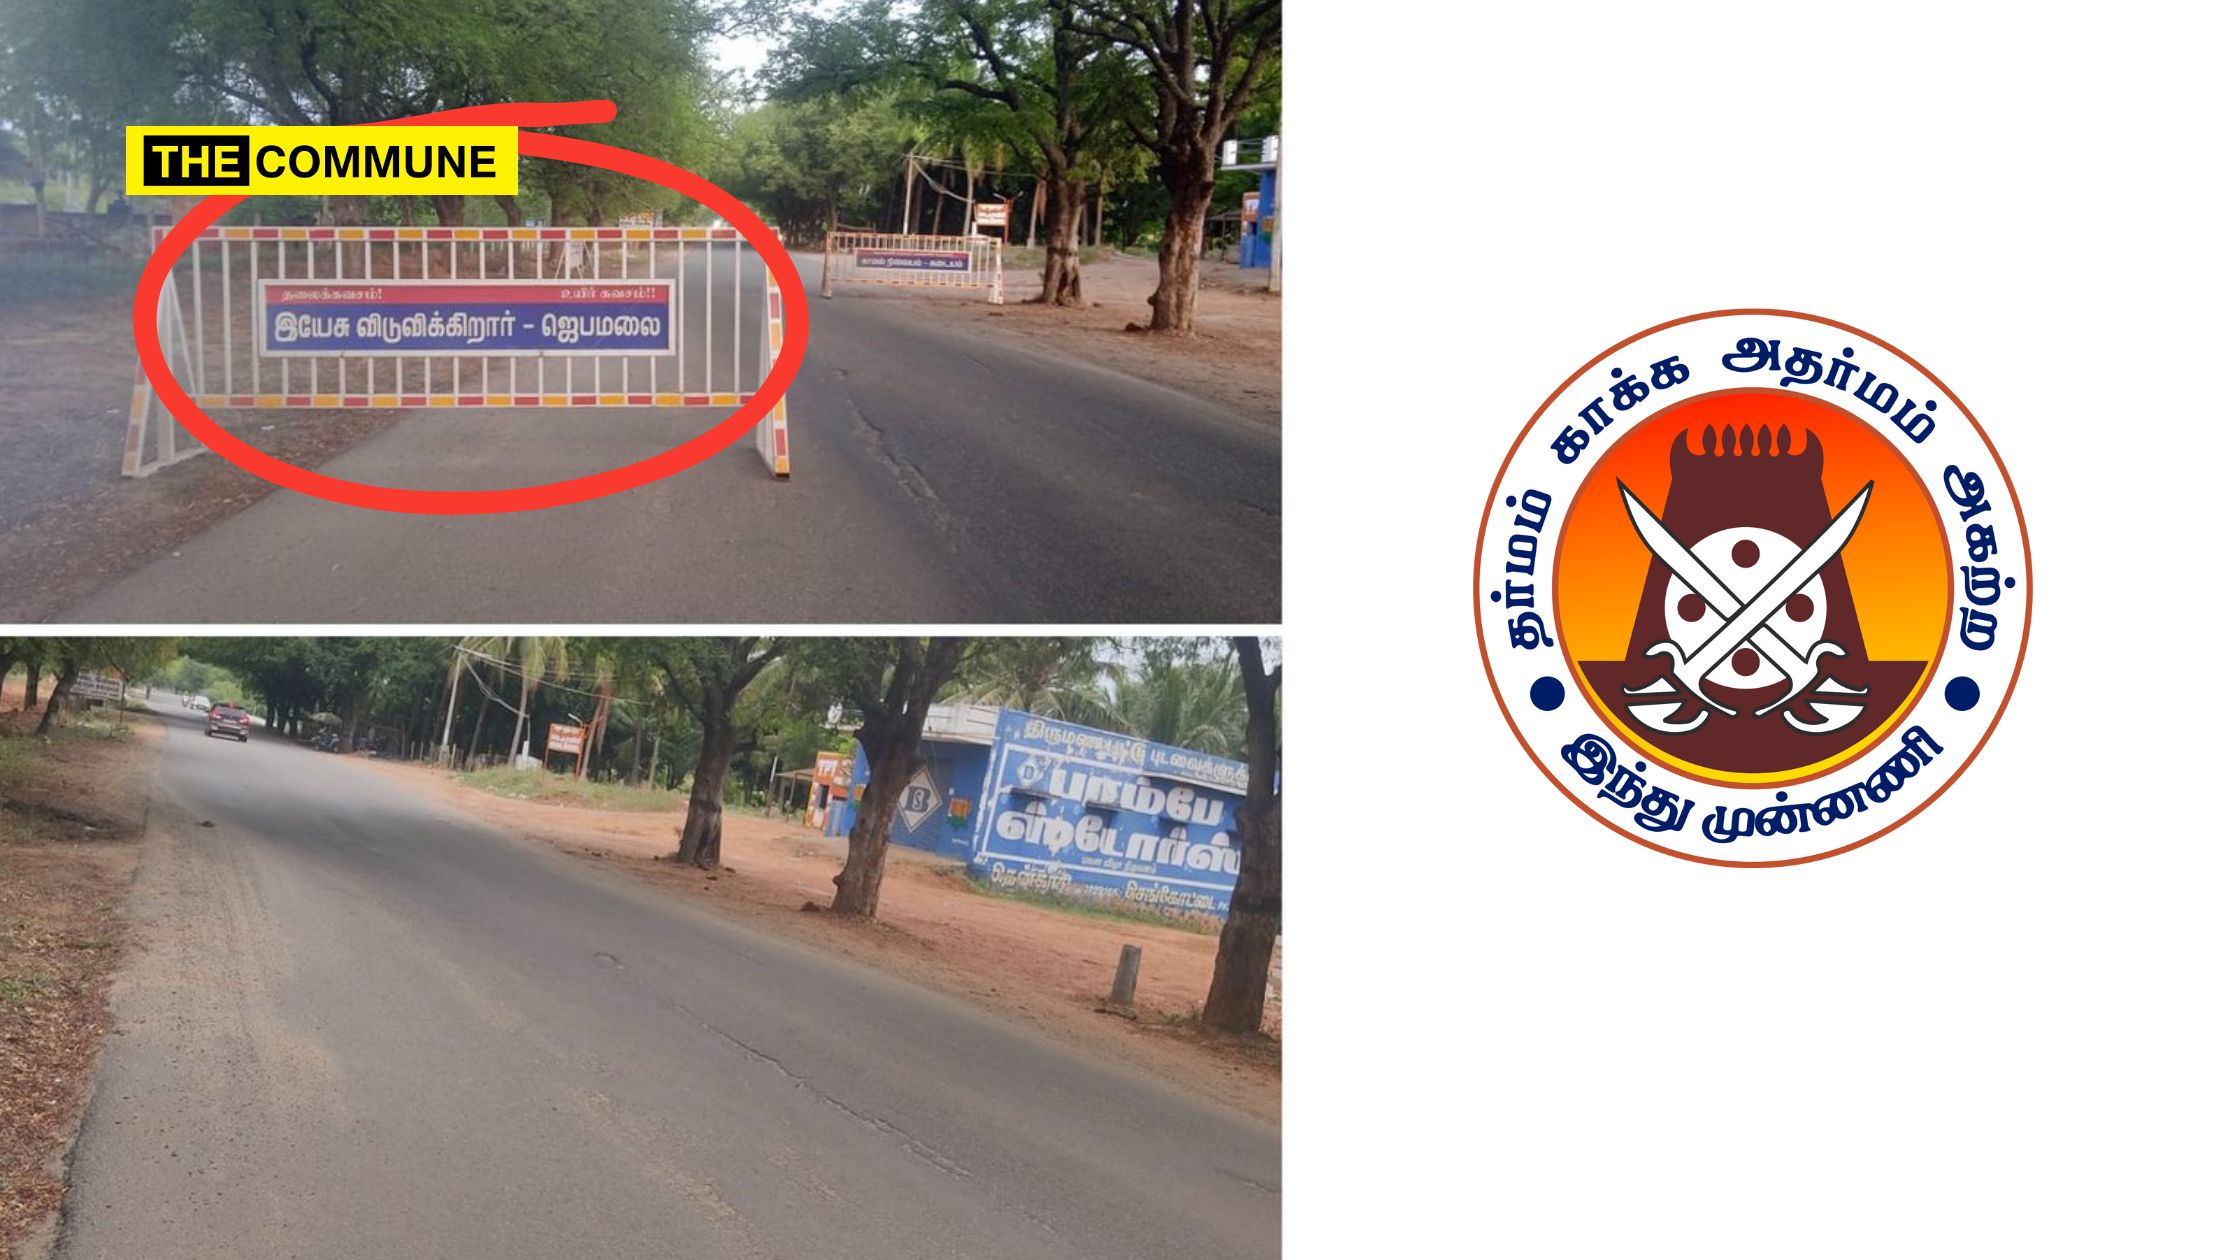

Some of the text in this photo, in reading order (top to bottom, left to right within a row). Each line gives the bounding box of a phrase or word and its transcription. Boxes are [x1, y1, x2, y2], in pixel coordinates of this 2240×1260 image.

[274, 311, 350, 342] இயேசு
[356, 310, 516, 344] விடுவிக்கிறார்
[541, 312, 661, 343] ஜெபமலை
[1049, 768, 1224, 827] பாம்பே
